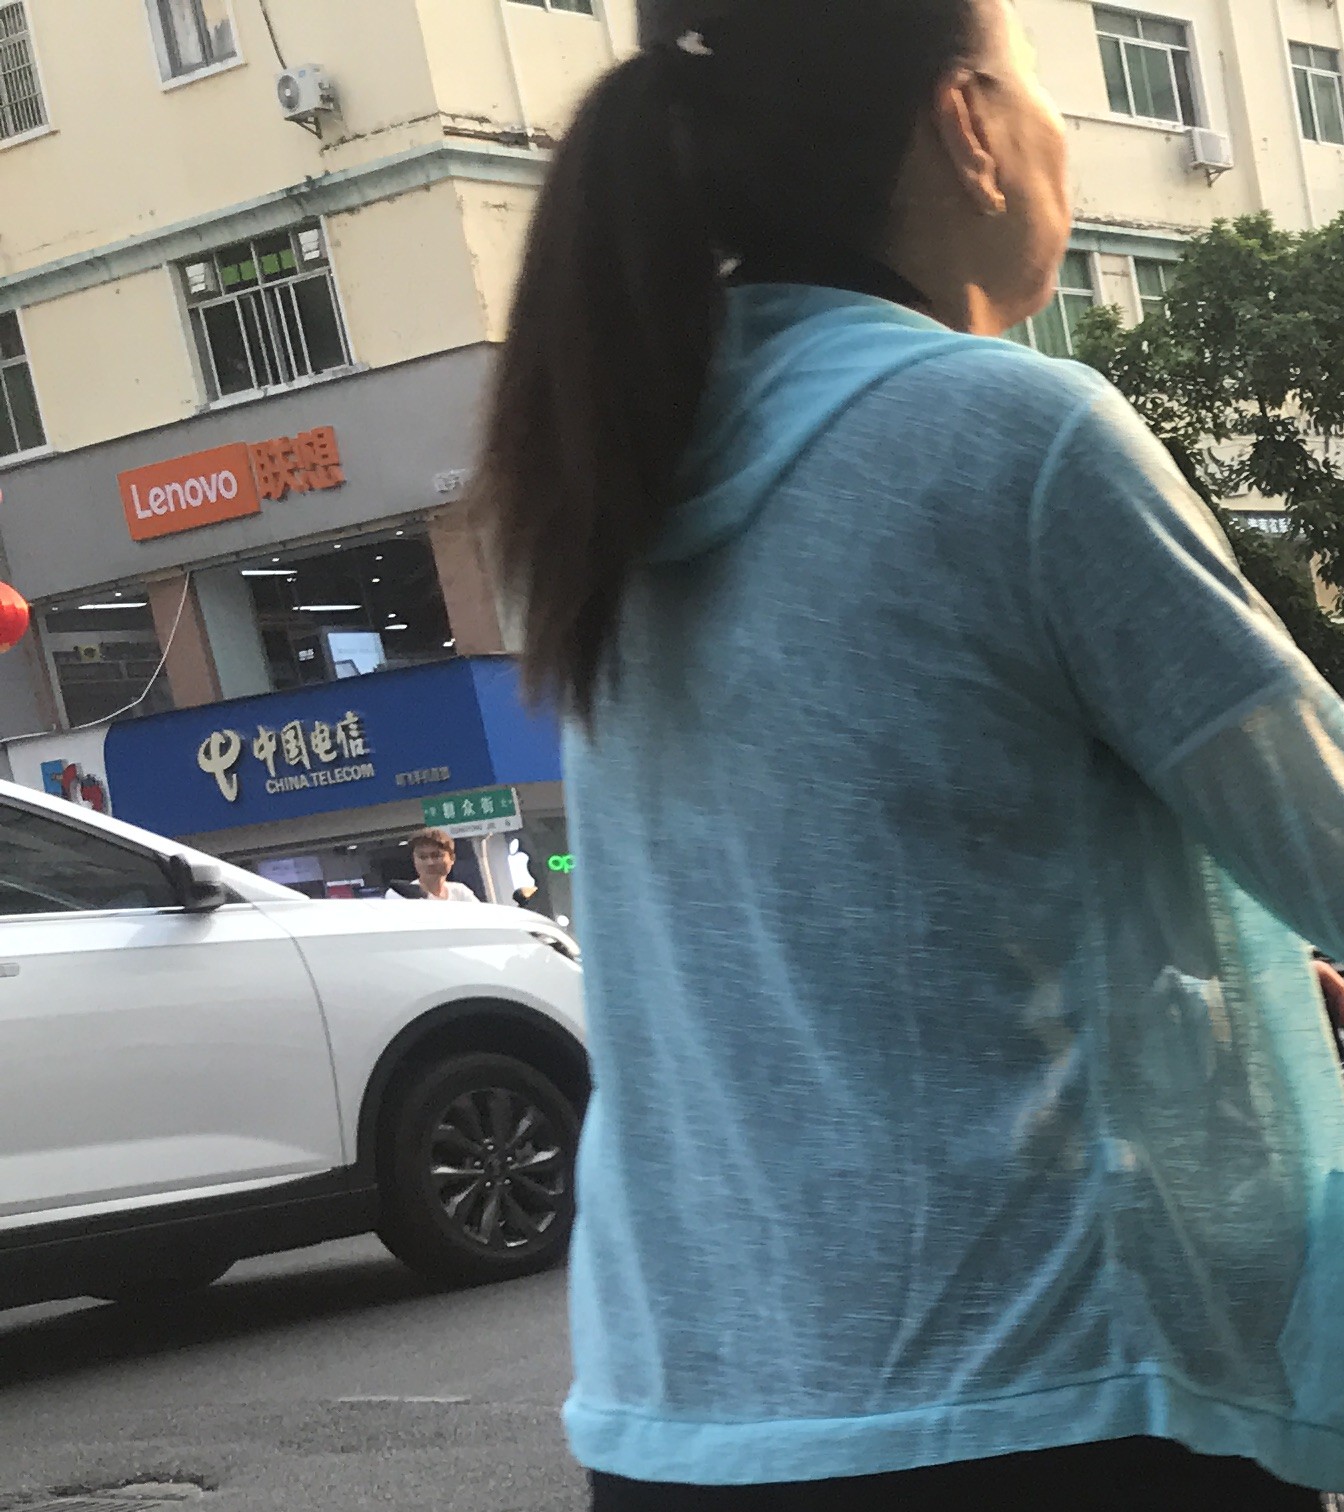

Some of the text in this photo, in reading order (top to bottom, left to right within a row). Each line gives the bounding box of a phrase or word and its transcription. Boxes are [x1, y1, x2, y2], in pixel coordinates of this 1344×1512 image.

[250, 425, 346, 501] 联想
[130, 470, 238, 519] Lenovo
[253, 710, 370, 778] 中国电信
[265, 772, 309, 794] CHINA
[310, 762, 375, 787] TELECOM
